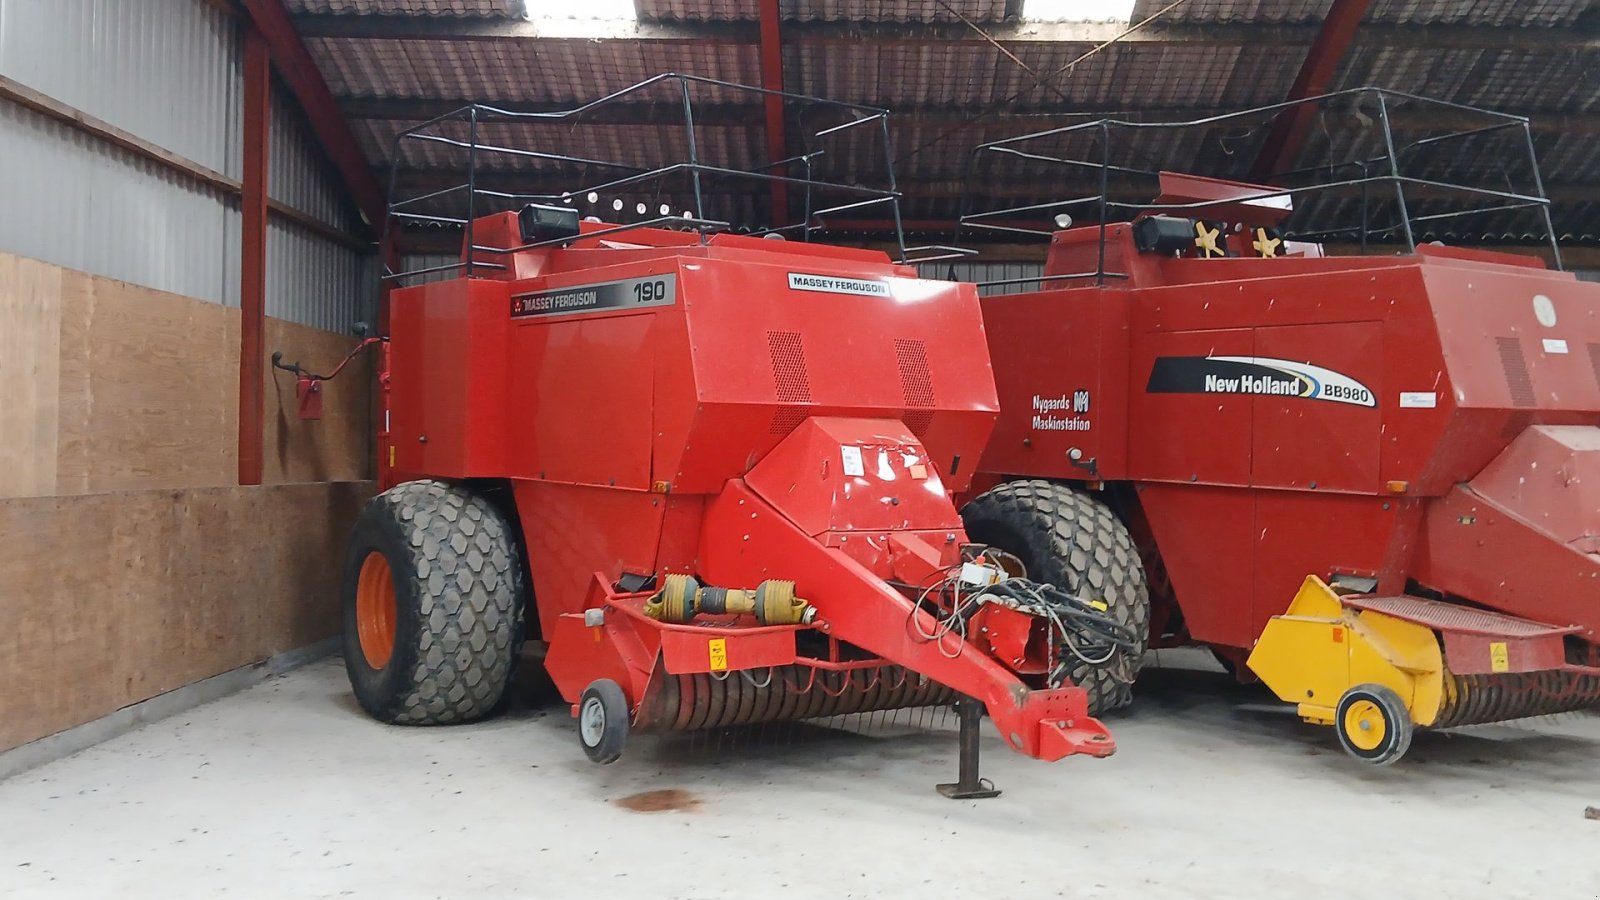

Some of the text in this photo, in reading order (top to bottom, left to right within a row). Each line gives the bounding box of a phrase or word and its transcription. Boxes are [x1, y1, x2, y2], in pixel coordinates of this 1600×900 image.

[633, 280, 666, 303] 190
[793, 277, 885, 293] MASSEY FERGUSON
[523, 291, 597, 311] MASSEY FERGUSON
[1205, 374, 1300, 396] New Holland
[1324, 384, 1369, 403] BB980
[1032, 394, 1070, 414] Nygaards
[1032, 414, 1091, 431] Maskinstation
